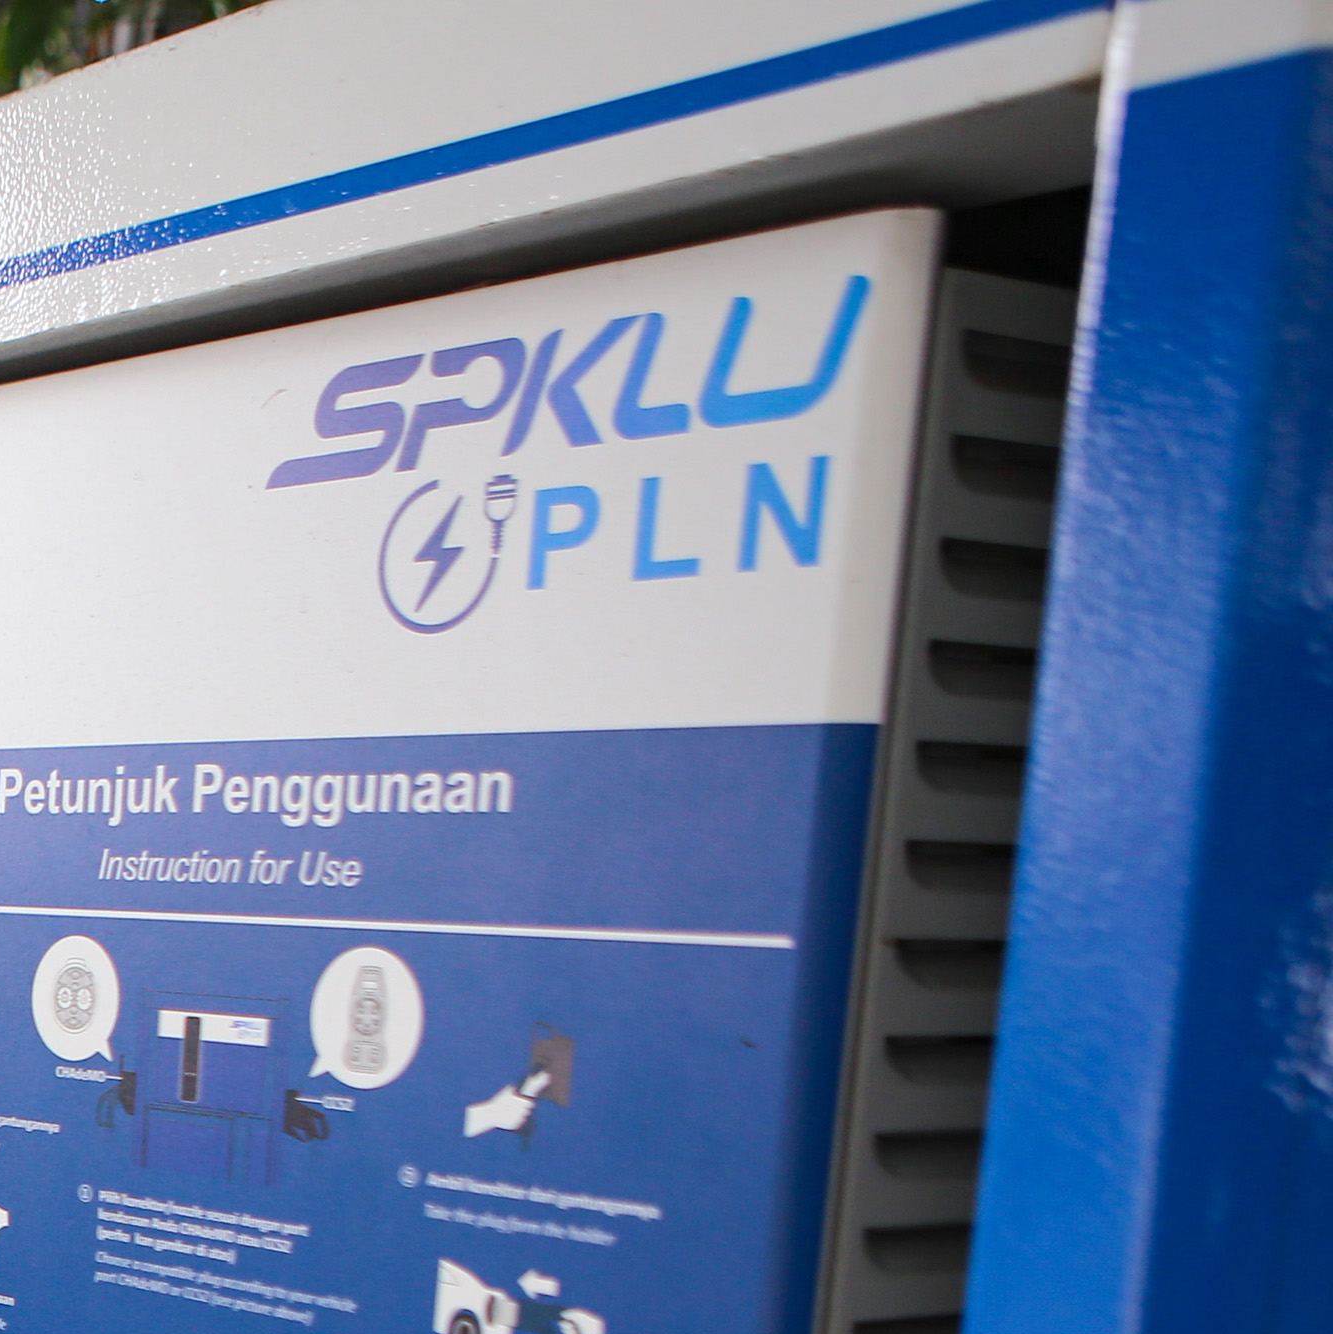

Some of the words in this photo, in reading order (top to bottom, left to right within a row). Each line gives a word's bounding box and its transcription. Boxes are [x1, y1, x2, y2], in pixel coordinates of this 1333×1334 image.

[265, 275, 870, 489] SPKLU
[527, 455, 829, 591] PLN
[192, 764, 512, 828] Penggunaan
[98, 848, 239, 885] Instruction
[248, 850, 292, 886] for
[297, 851, 363, 887] Use
